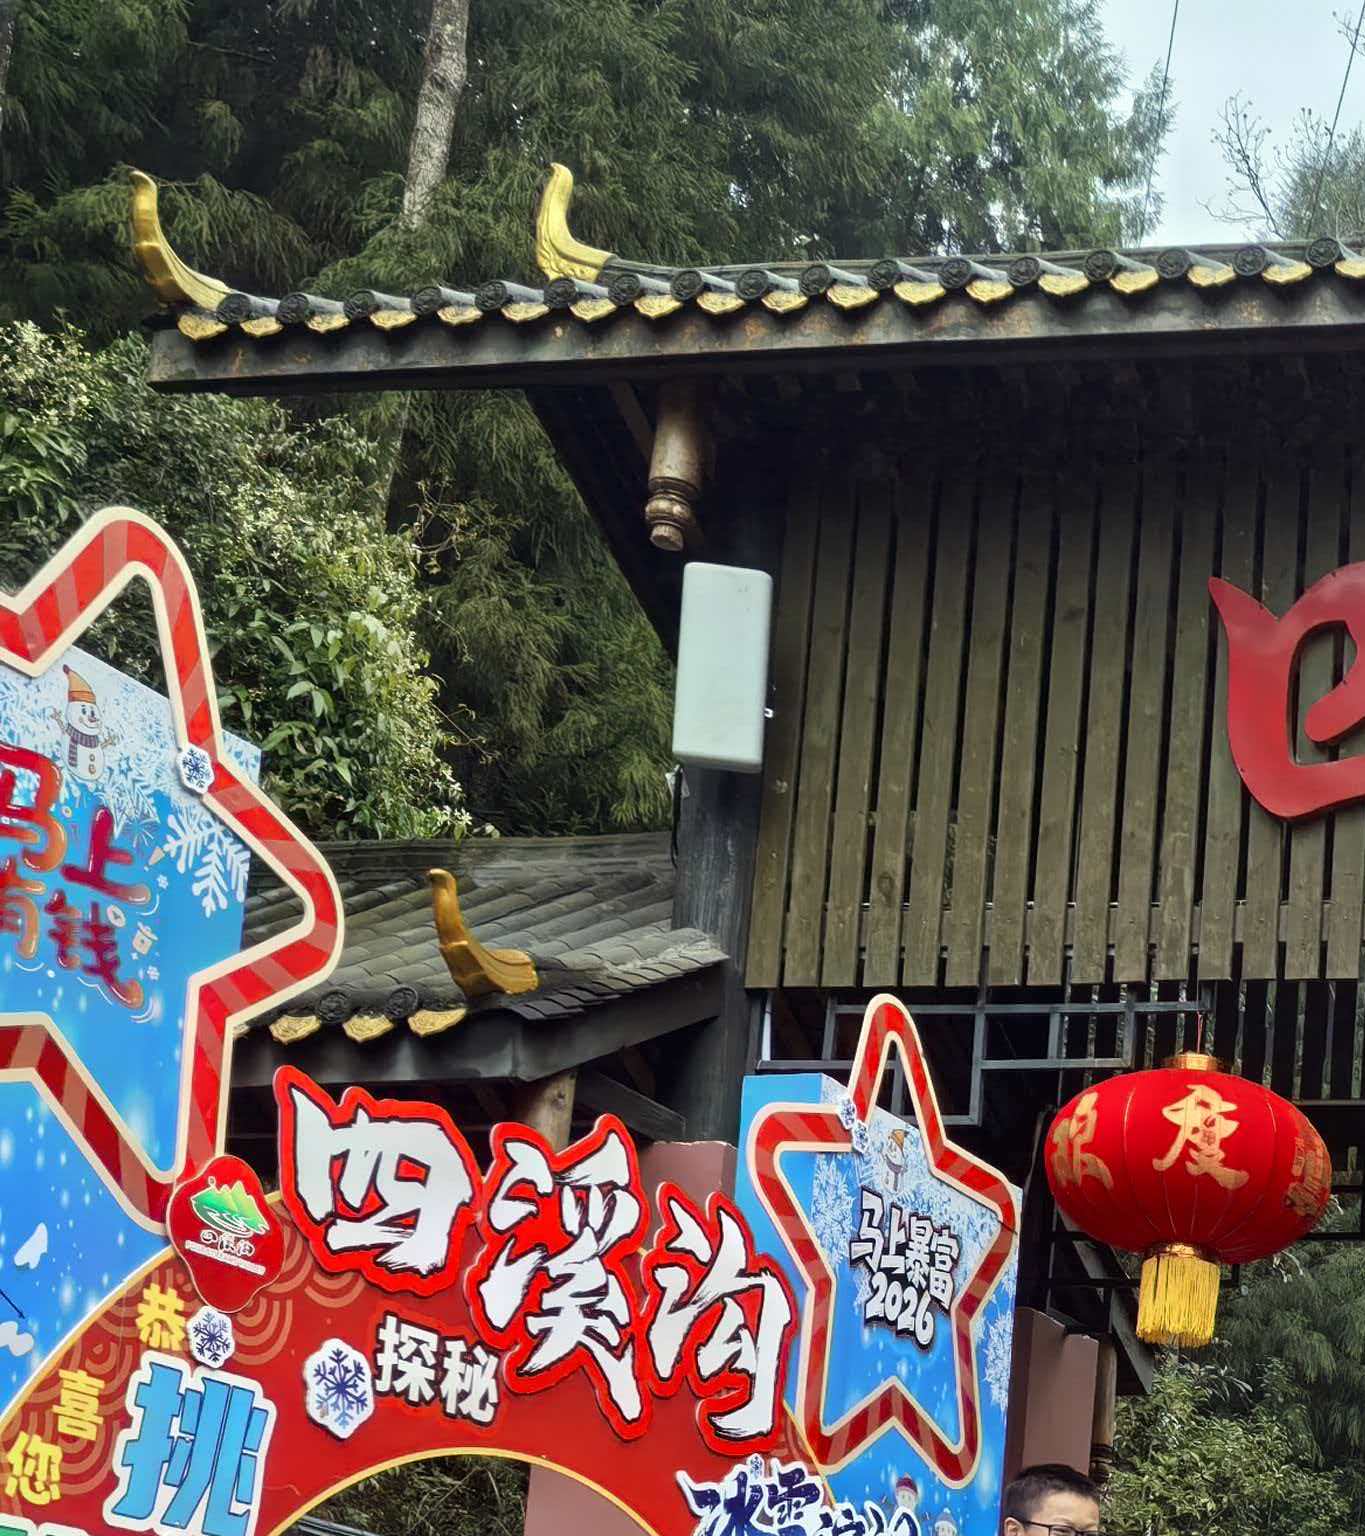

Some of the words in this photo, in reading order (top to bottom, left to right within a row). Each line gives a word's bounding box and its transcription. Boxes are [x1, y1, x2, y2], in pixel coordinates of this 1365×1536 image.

[290, 1086, 792, 1439] 四溪沟
[850, 1189, 960, 1311] 马上暴富
[865, 1271, 935, 1345] 2026
[376, 1314, 500, 1423] 探秘
